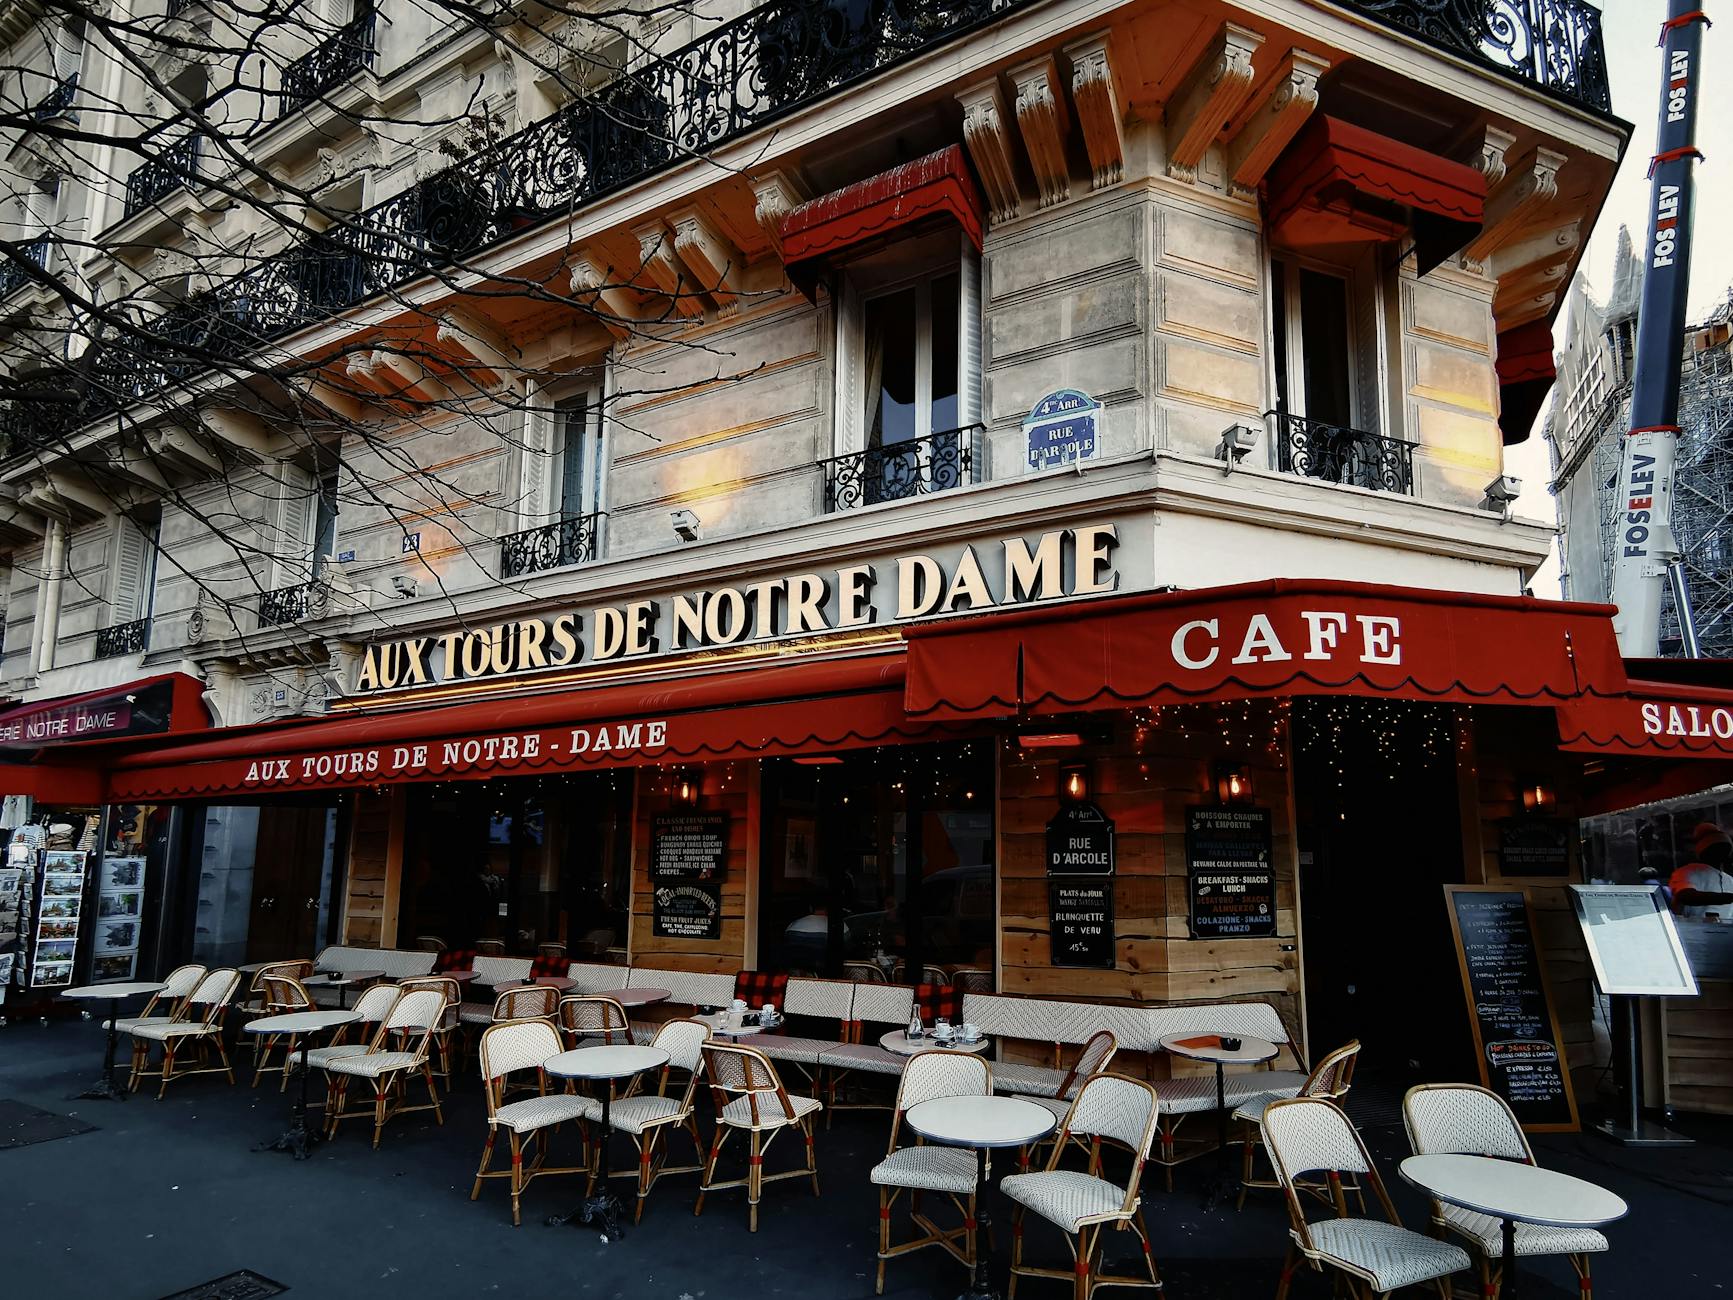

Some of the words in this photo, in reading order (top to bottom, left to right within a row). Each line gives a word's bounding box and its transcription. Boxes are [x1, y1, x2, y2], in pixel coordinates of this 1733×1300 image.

[1667, 50, 1689, 123] FOSELEV
[1653, 185, 1680, 268] FOSELEV
[1048, 426, 1073, 441] RUE
[1623, 454, 1656, 558] FOSELEV
[403, 535, 418, 552] 23
[356, 638, 436, 691] AUX
[439, 613, 582, 680] TOURS
[592, 600, 659, 660] DE
[671, 564, 877, 650] NOTRE
[895, 523, 1120, 620] DAME
[1171, 611, 1401, 669] CAFE
[27, 719, 69, 738] NOTRE
[76, 712, 116, 732] DAME
[1641, 703, 1733, 739] SALO
[245, 760, 290, 782] AUX
[303, 750, 379, 778] TOURS
[392, 746, 428, 769] DE
[442, 734, 540, 765] NOTRE
[569, 721, 667, 754] DAME
[1195, 811, 1232, 820] BOISSONS
[1233, 812, 1263, 821] CHAUDES
[1215, 821, 1251, 829] EMPORTER
[1069, 837, 1091, 849] RUE
[1222, 884, 1246, 893] LUNCH
[1055, 912, 1104, 922] BLANQUETTE
[1064, 926, 1075, 934] DE
[1080, 926, 1101, 934] VEAU
